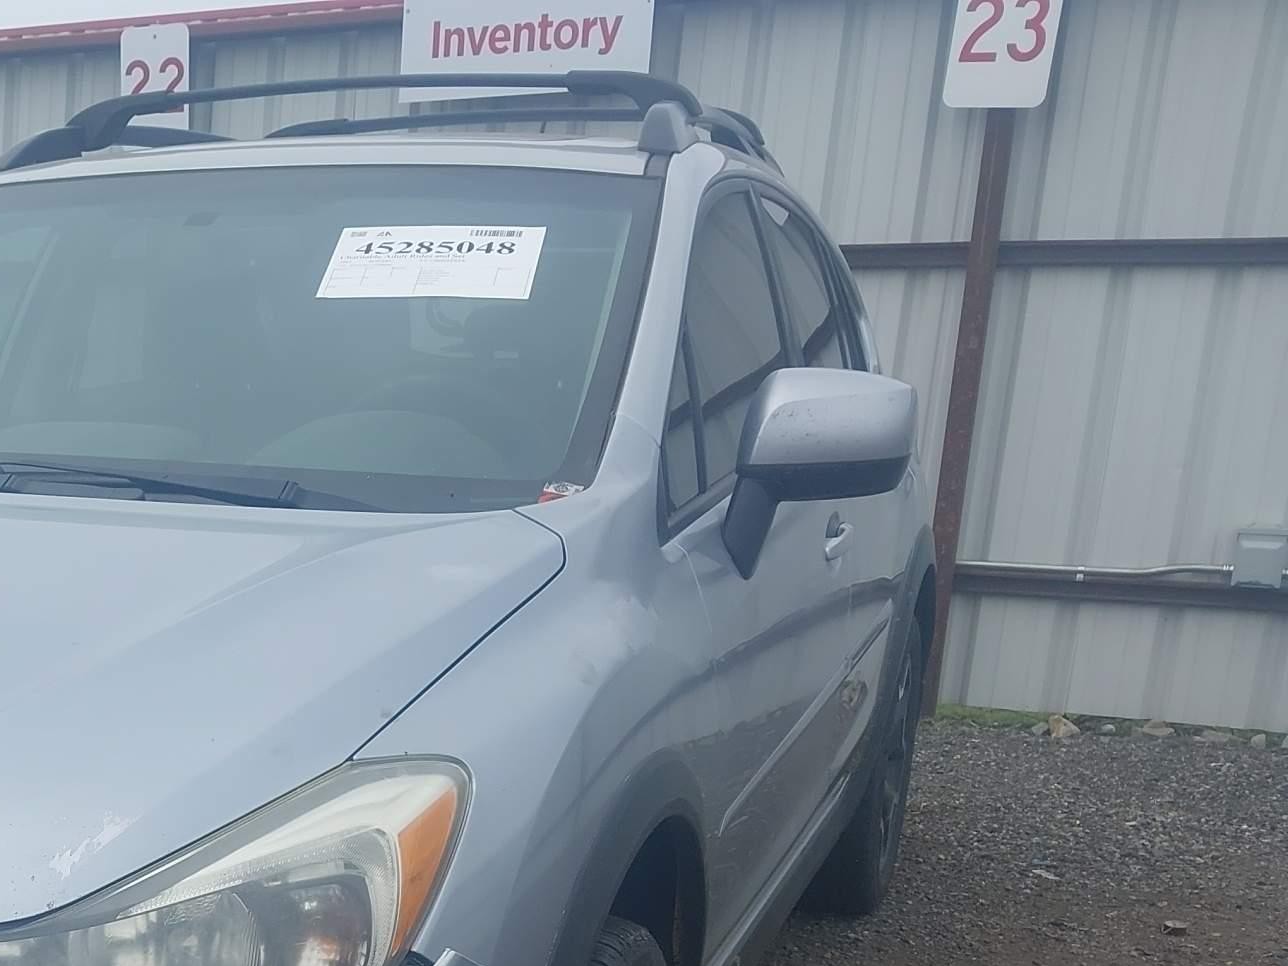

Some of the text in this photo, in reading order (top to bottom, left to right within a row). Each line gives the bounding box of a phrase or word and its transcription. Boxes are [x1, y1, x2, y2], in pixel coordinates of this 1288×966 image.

[431, 13, 624, 59] Inventory
[958, 0, 1050, 62] 23
[354, 240, 517, 255] 45285048
